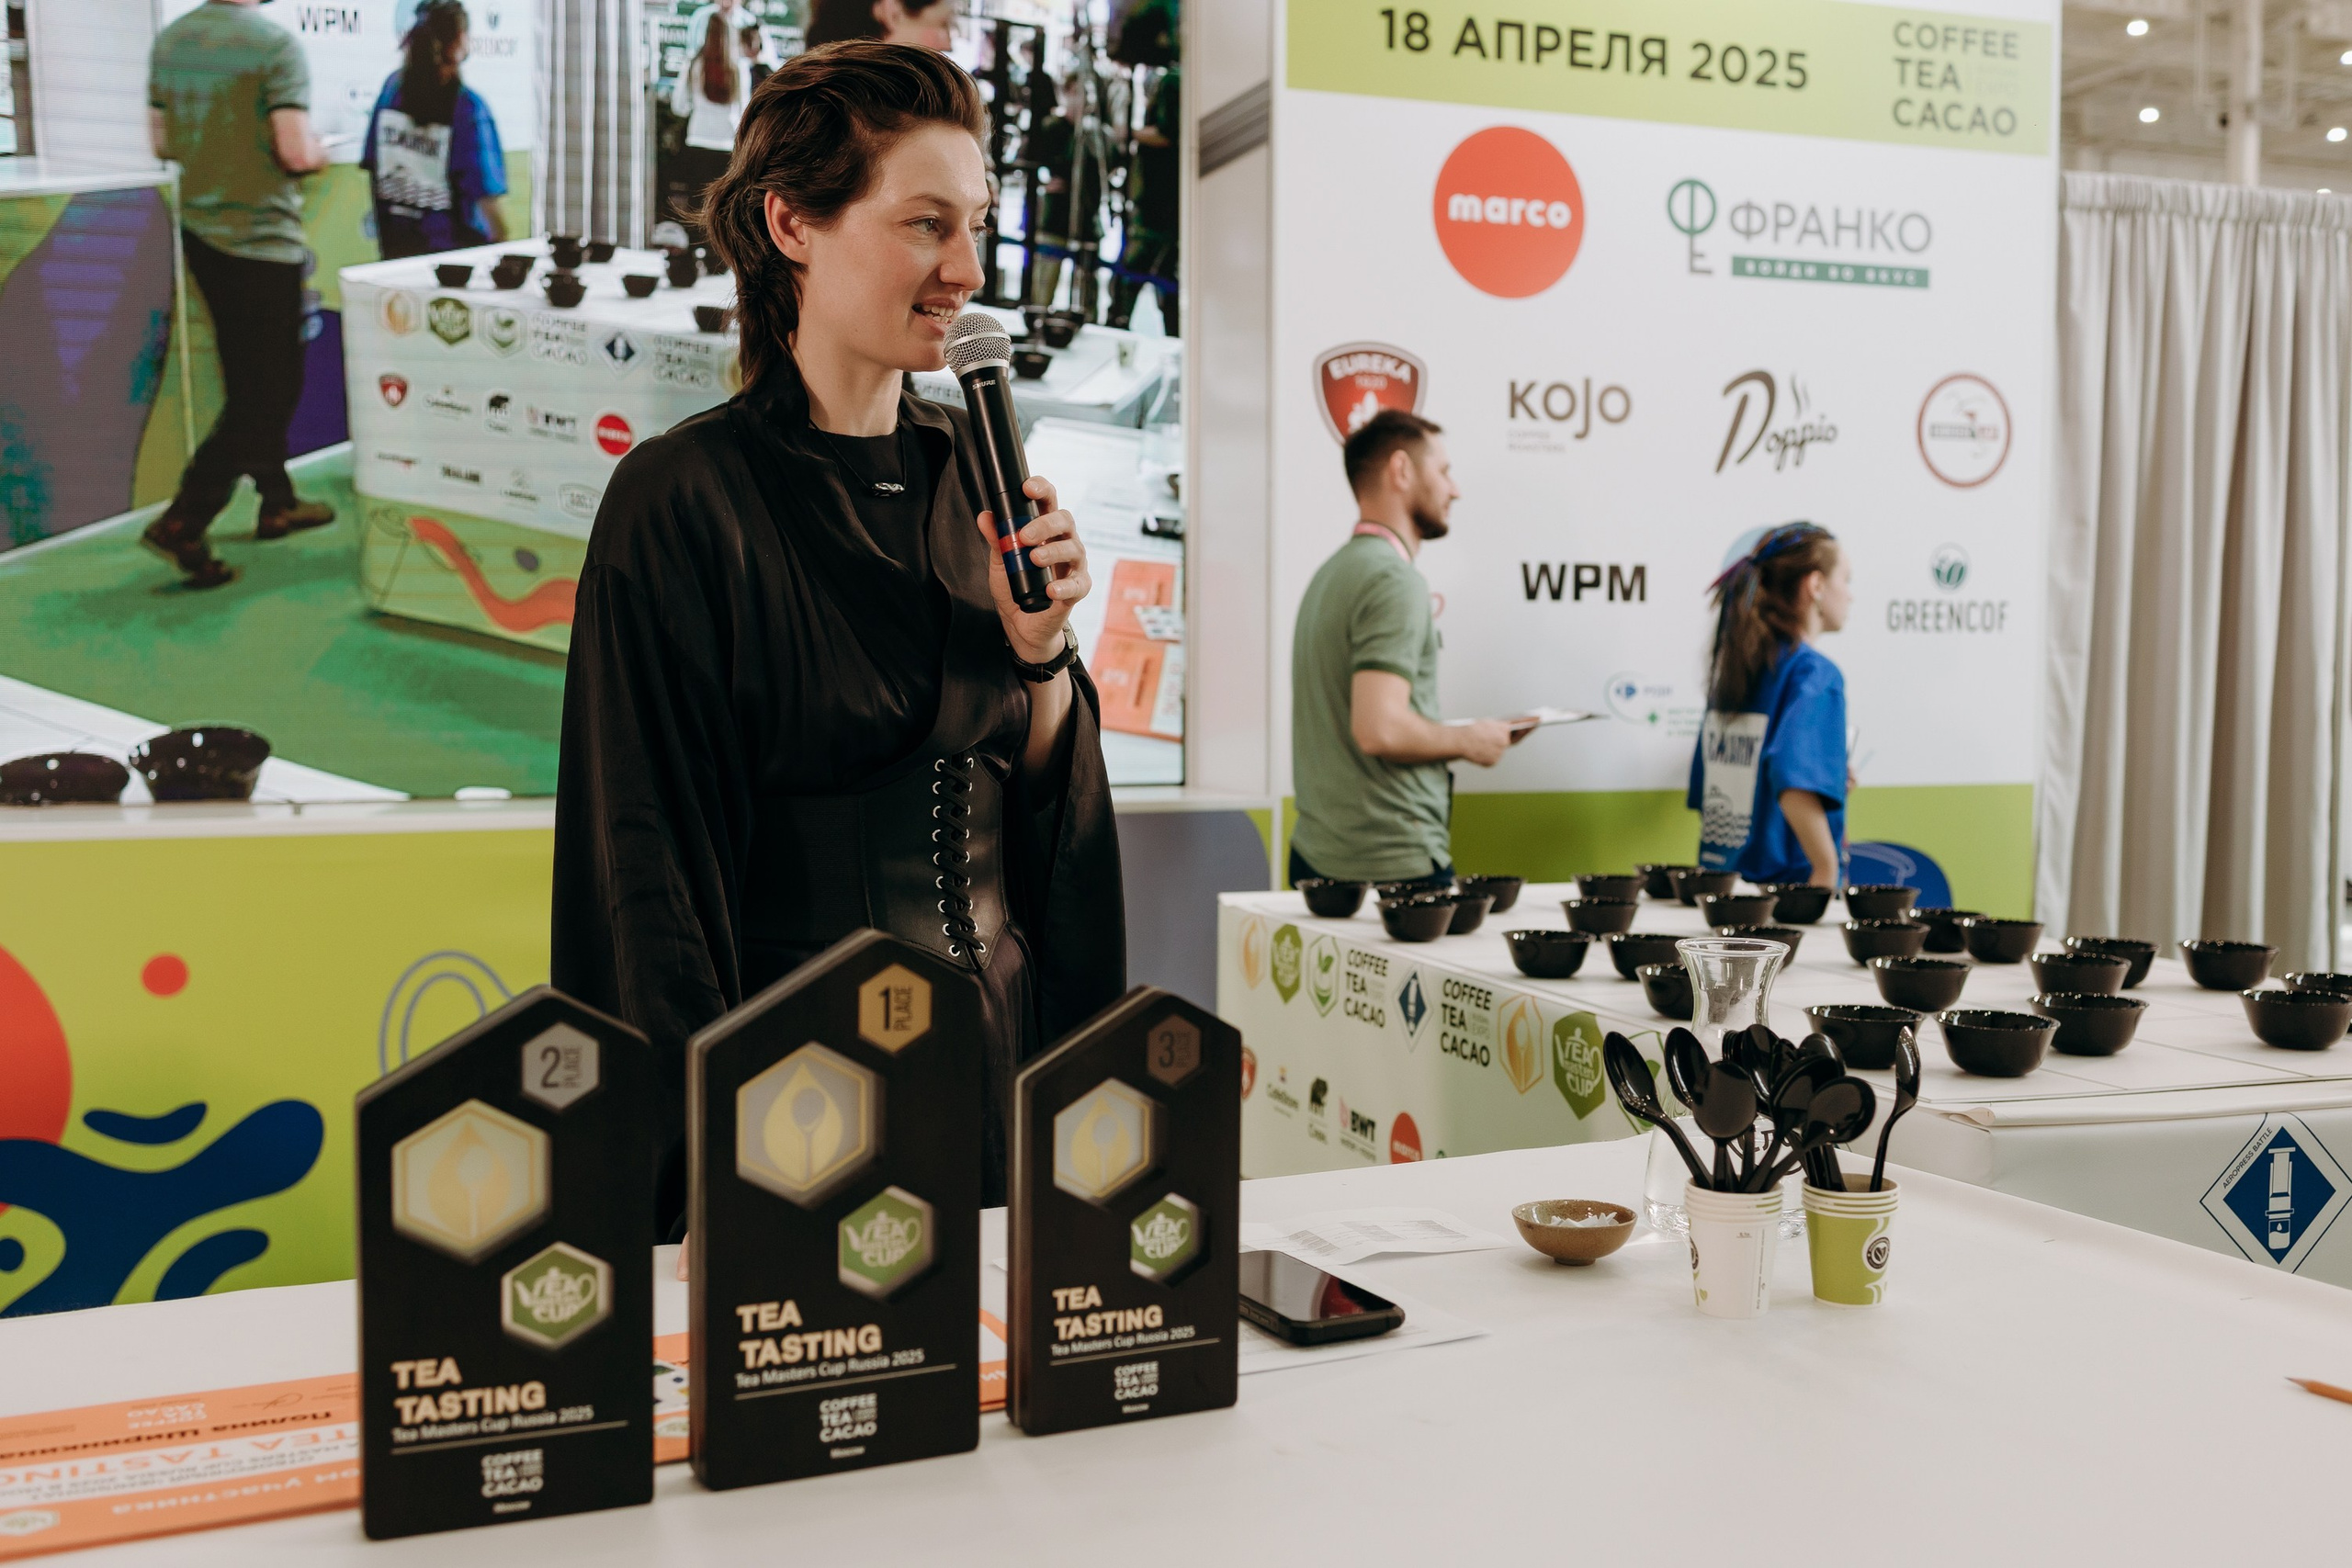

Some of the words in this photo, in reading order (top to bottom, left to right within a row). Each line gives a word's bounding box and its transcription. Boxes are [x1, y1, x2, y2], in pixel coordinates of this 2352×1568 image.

[298, 7, 362, 34] WPM
[1381, 9, 1430, 51] 18
[1453, 17, 1667, 75] АПРЕЛЯ
[1690, 42, 1807, 89] 2025
[1894, 21, 2018, 59] COFFEE
[1894, 58, 1961, 90] TEA
[1893, 98, 2018, 136] CACAO
[1448, 193, 1572, 230] marco
[1730, 200, 1931, 254] ФРАНКО
[972, 379, 996, 389] SHURE
[1328, 353, 1411, 384] EUREKA
[1715, 370, 1838, 474] Doppio
[1521, 563, 1646, 602] WPM
[1887, 599, 2009, 634] GREENCOF
[1348, 949, 1389, 976] COFFEE
[1345, 972, 1367, 996] TEA
[1443, 978, 1493, 1011] COFFEE
[879, 987, 890, 1031] 1
[893, 986, 912, 1031] PLACE
[1344, 998, 1385, 1029] CACAO
[1442, 1004, 1467, 1032] TEA
[1159, 1032, 1174, 1067] 3
[1441, 1032, 1490, 1067] CACAO
[1565, 1040, 1593, 1068] TEA
[540, 1046, 560, 1089] 2
[1566, 1072, 1595, 1098] CUP
[2222, 1150, 2254, 1189] AEROPRESS
[2252, 1127, 2273, 1153] BATTLE
[1052, 1285, 1102, 1312] TEA
[736, 1300, 803, 1333] TEA
[1054, 1304, 1163, 1341] TASTING
[739, 1324, 882, 1369] TASTING
[1050, 1344, 1070, 1357] Tea
[1070, 1338, 1113, 1354] Masters
[1114, 1335, 1135, 1348] Cup
[1136, 1329, 1169, 1344] Russia
[1170, 1325, 1195, 1340] 2025
[390, 1357, 462, 1390] TEA
[735, 1371, 761, 1388] Tea
[762, 1365, 817, 1384] Masters
[819, 1360, 846, 1377] Cup
[848, 1354, 890, 1371] Russia
[891, 1348, 925, 1367] 2025
[1114, 1360, 1159, 1377] COFFEE
[1114, 1374, 1139, 1388] TEA
[393, 1381, 547, 1425] TASTING
[819, 1393, 877, 1414] COFFEE
[1114, 1383, 1159, 1401] CACAO
[211, 1411, 332, 1435] Полина
[391, 1426, 419, 1443] Tea
[419, 1420, 480, 1440] Masters
[480, 1416, 510, 1433] Cup
[511, 1410, 557, 1428] Russia
[558, 1404, 594, 1424] 2025
[819, 1422, 878, 1442] CACAO
[820, 1410, 853, 1427] TEA
[248, 1427, 358, 1452] TEA
[481, 1449, 544, 1470] COFFEE
[481, 1465, 516, 1483] TEA
[481, 1475, 544, 1498] CACAO
